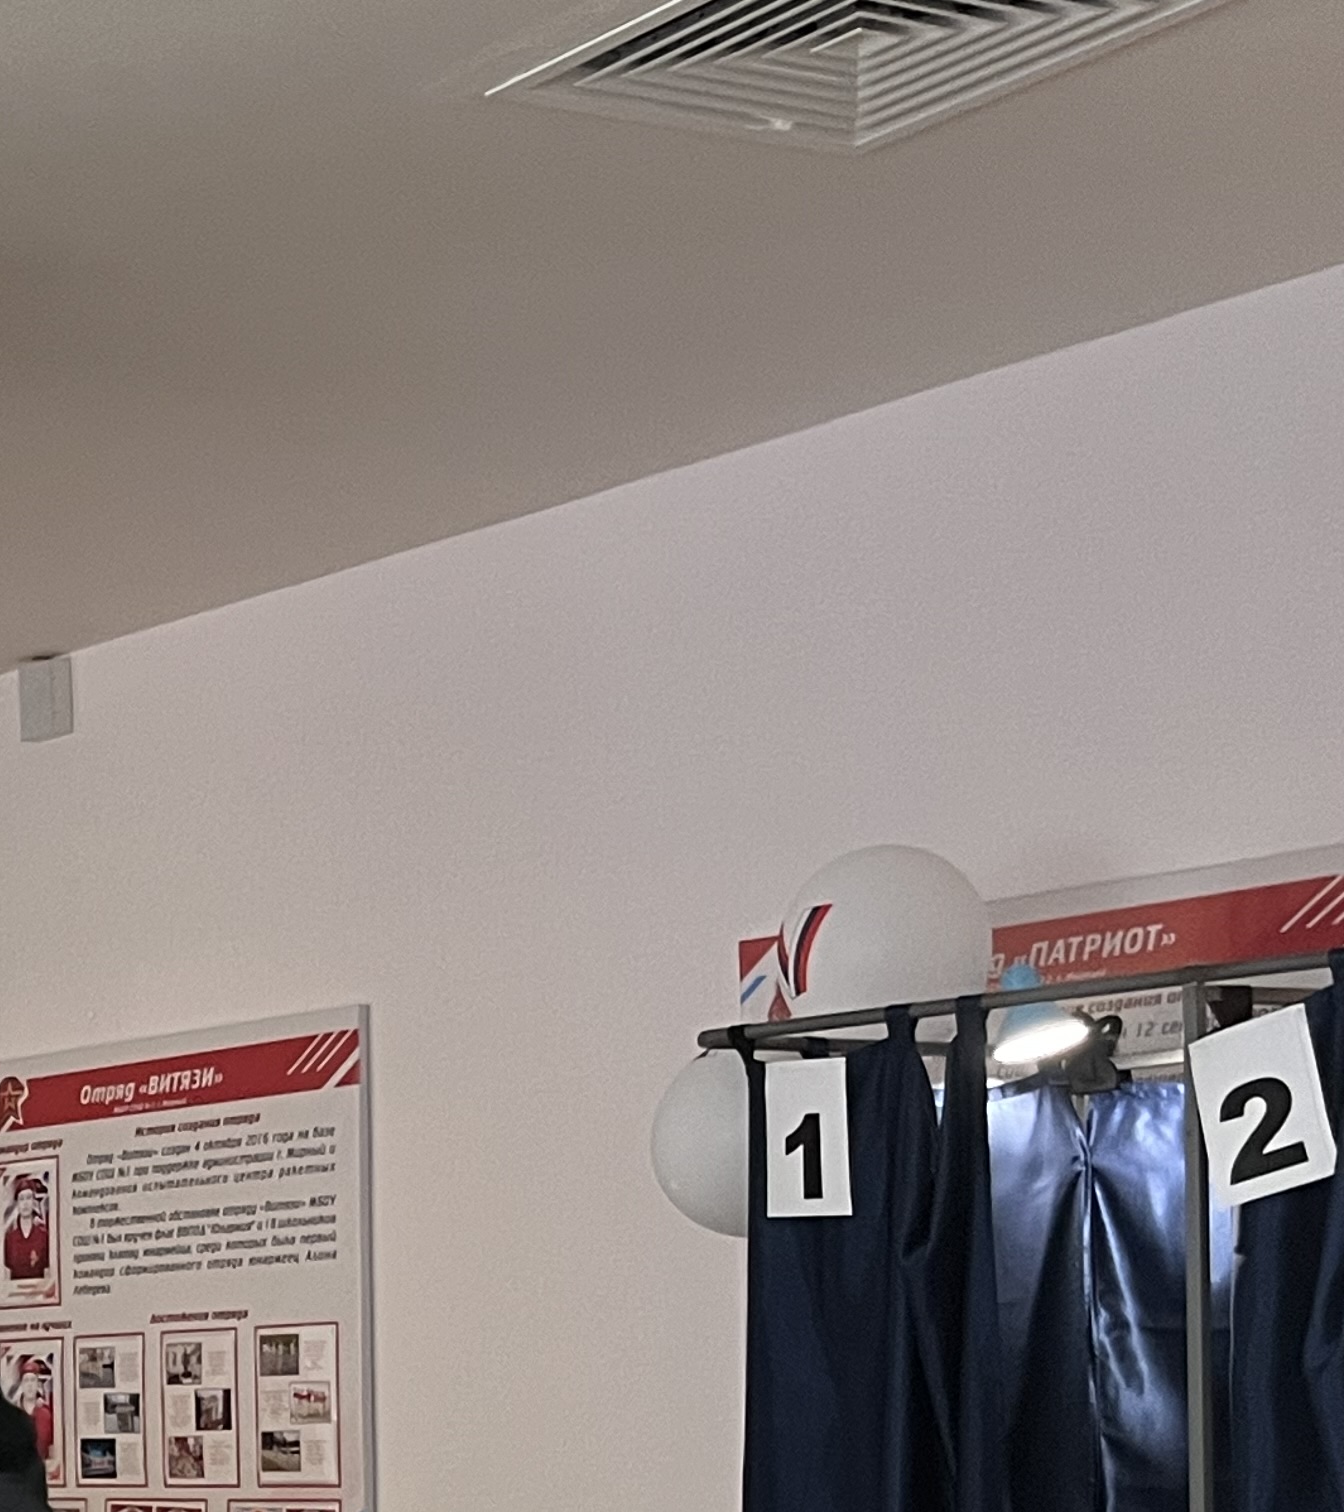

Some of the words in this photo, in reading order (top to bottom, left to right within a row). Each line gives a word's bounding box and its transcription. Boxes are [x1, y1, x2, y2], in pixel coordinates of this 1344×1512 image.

[1014, 923, 1176, 967] «ПАТРИОТ»
[1089, 993, 1162, 1015] создания
[79, 1081, 135, 1106] Отряд
[139, 1066, 223, 1096] «ВИТЯЗИ»
[1219, 1077, 1310, 1186] 2
[785, 1112, 824, 1200] 1
